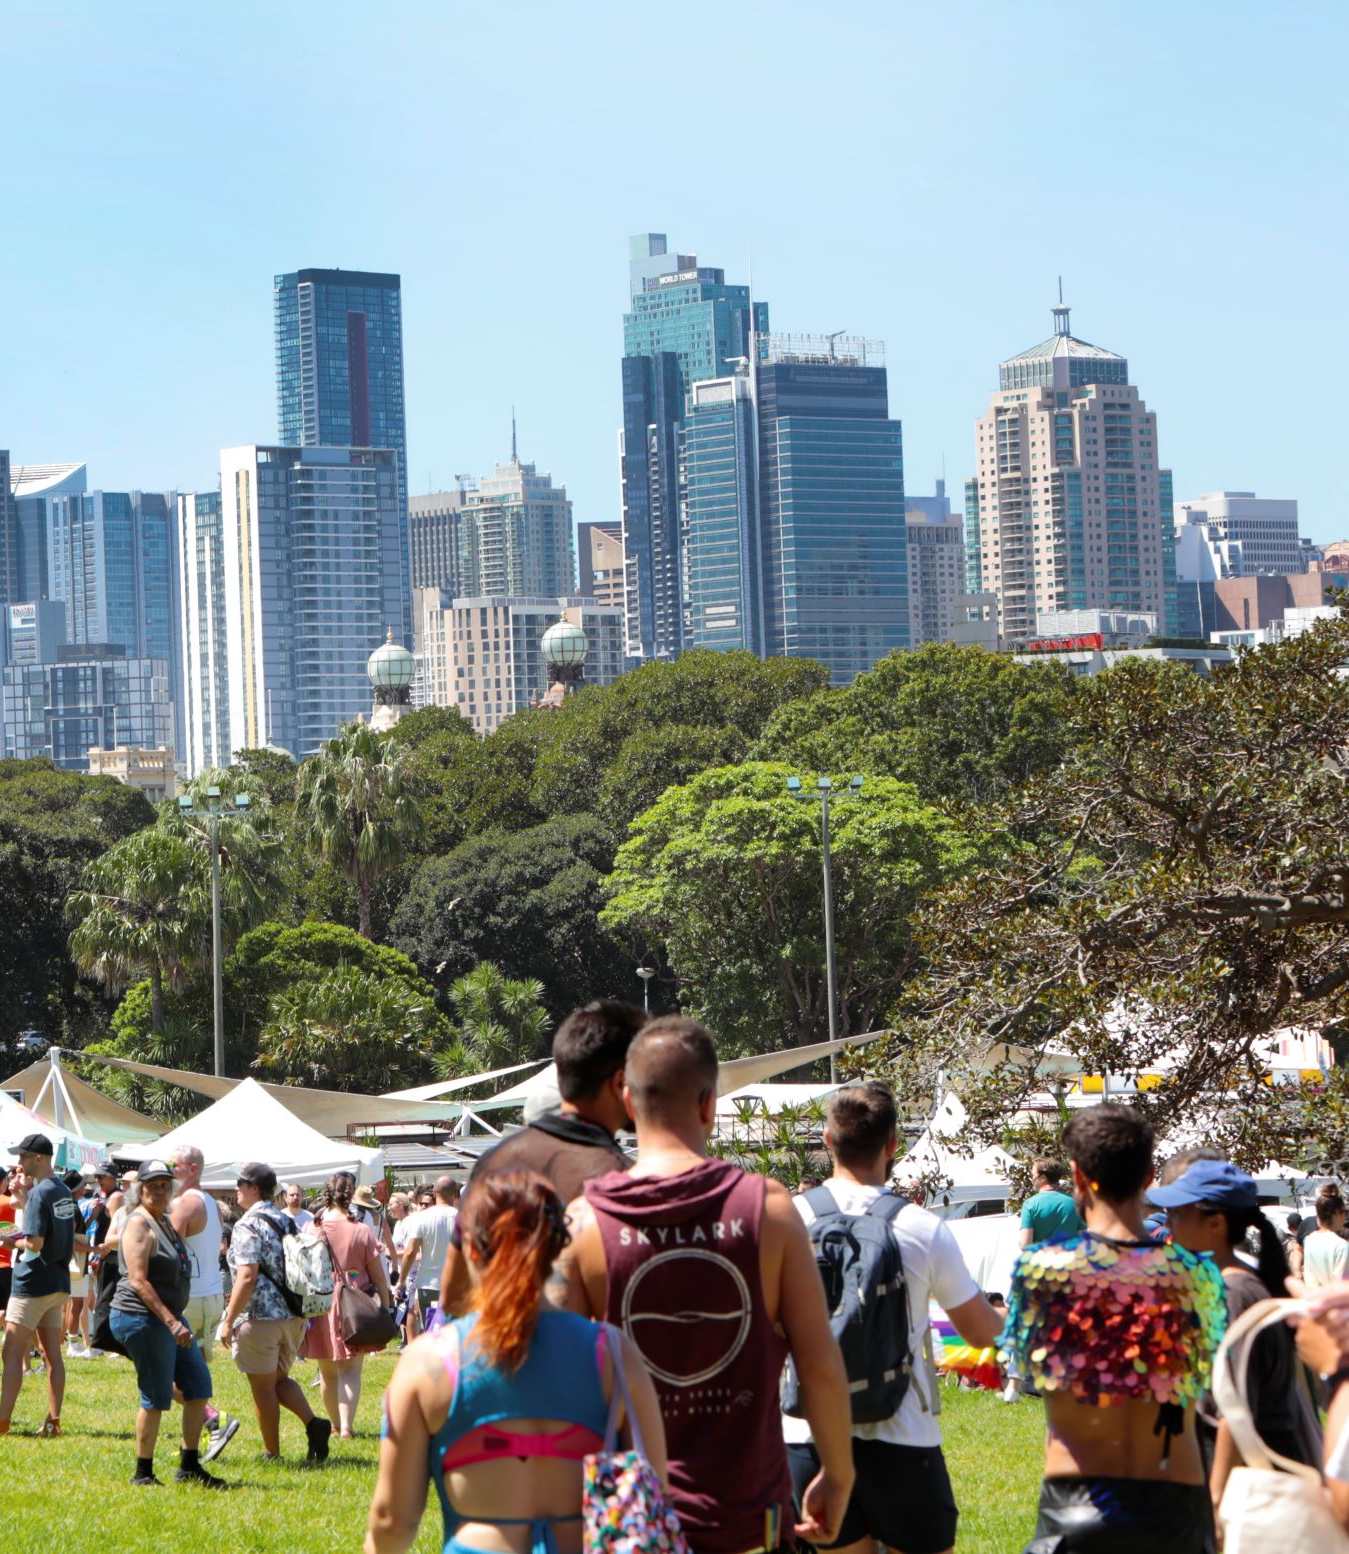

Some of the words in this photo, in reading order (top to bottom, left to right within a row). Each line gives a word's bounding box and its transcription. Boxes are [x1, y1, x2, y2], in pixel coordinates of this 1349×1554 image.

[659, 274, 678, 284] WORLD
[678, 271, 698, 281] TOWER
[619, 1218, 745, 1246] SKYLARK
